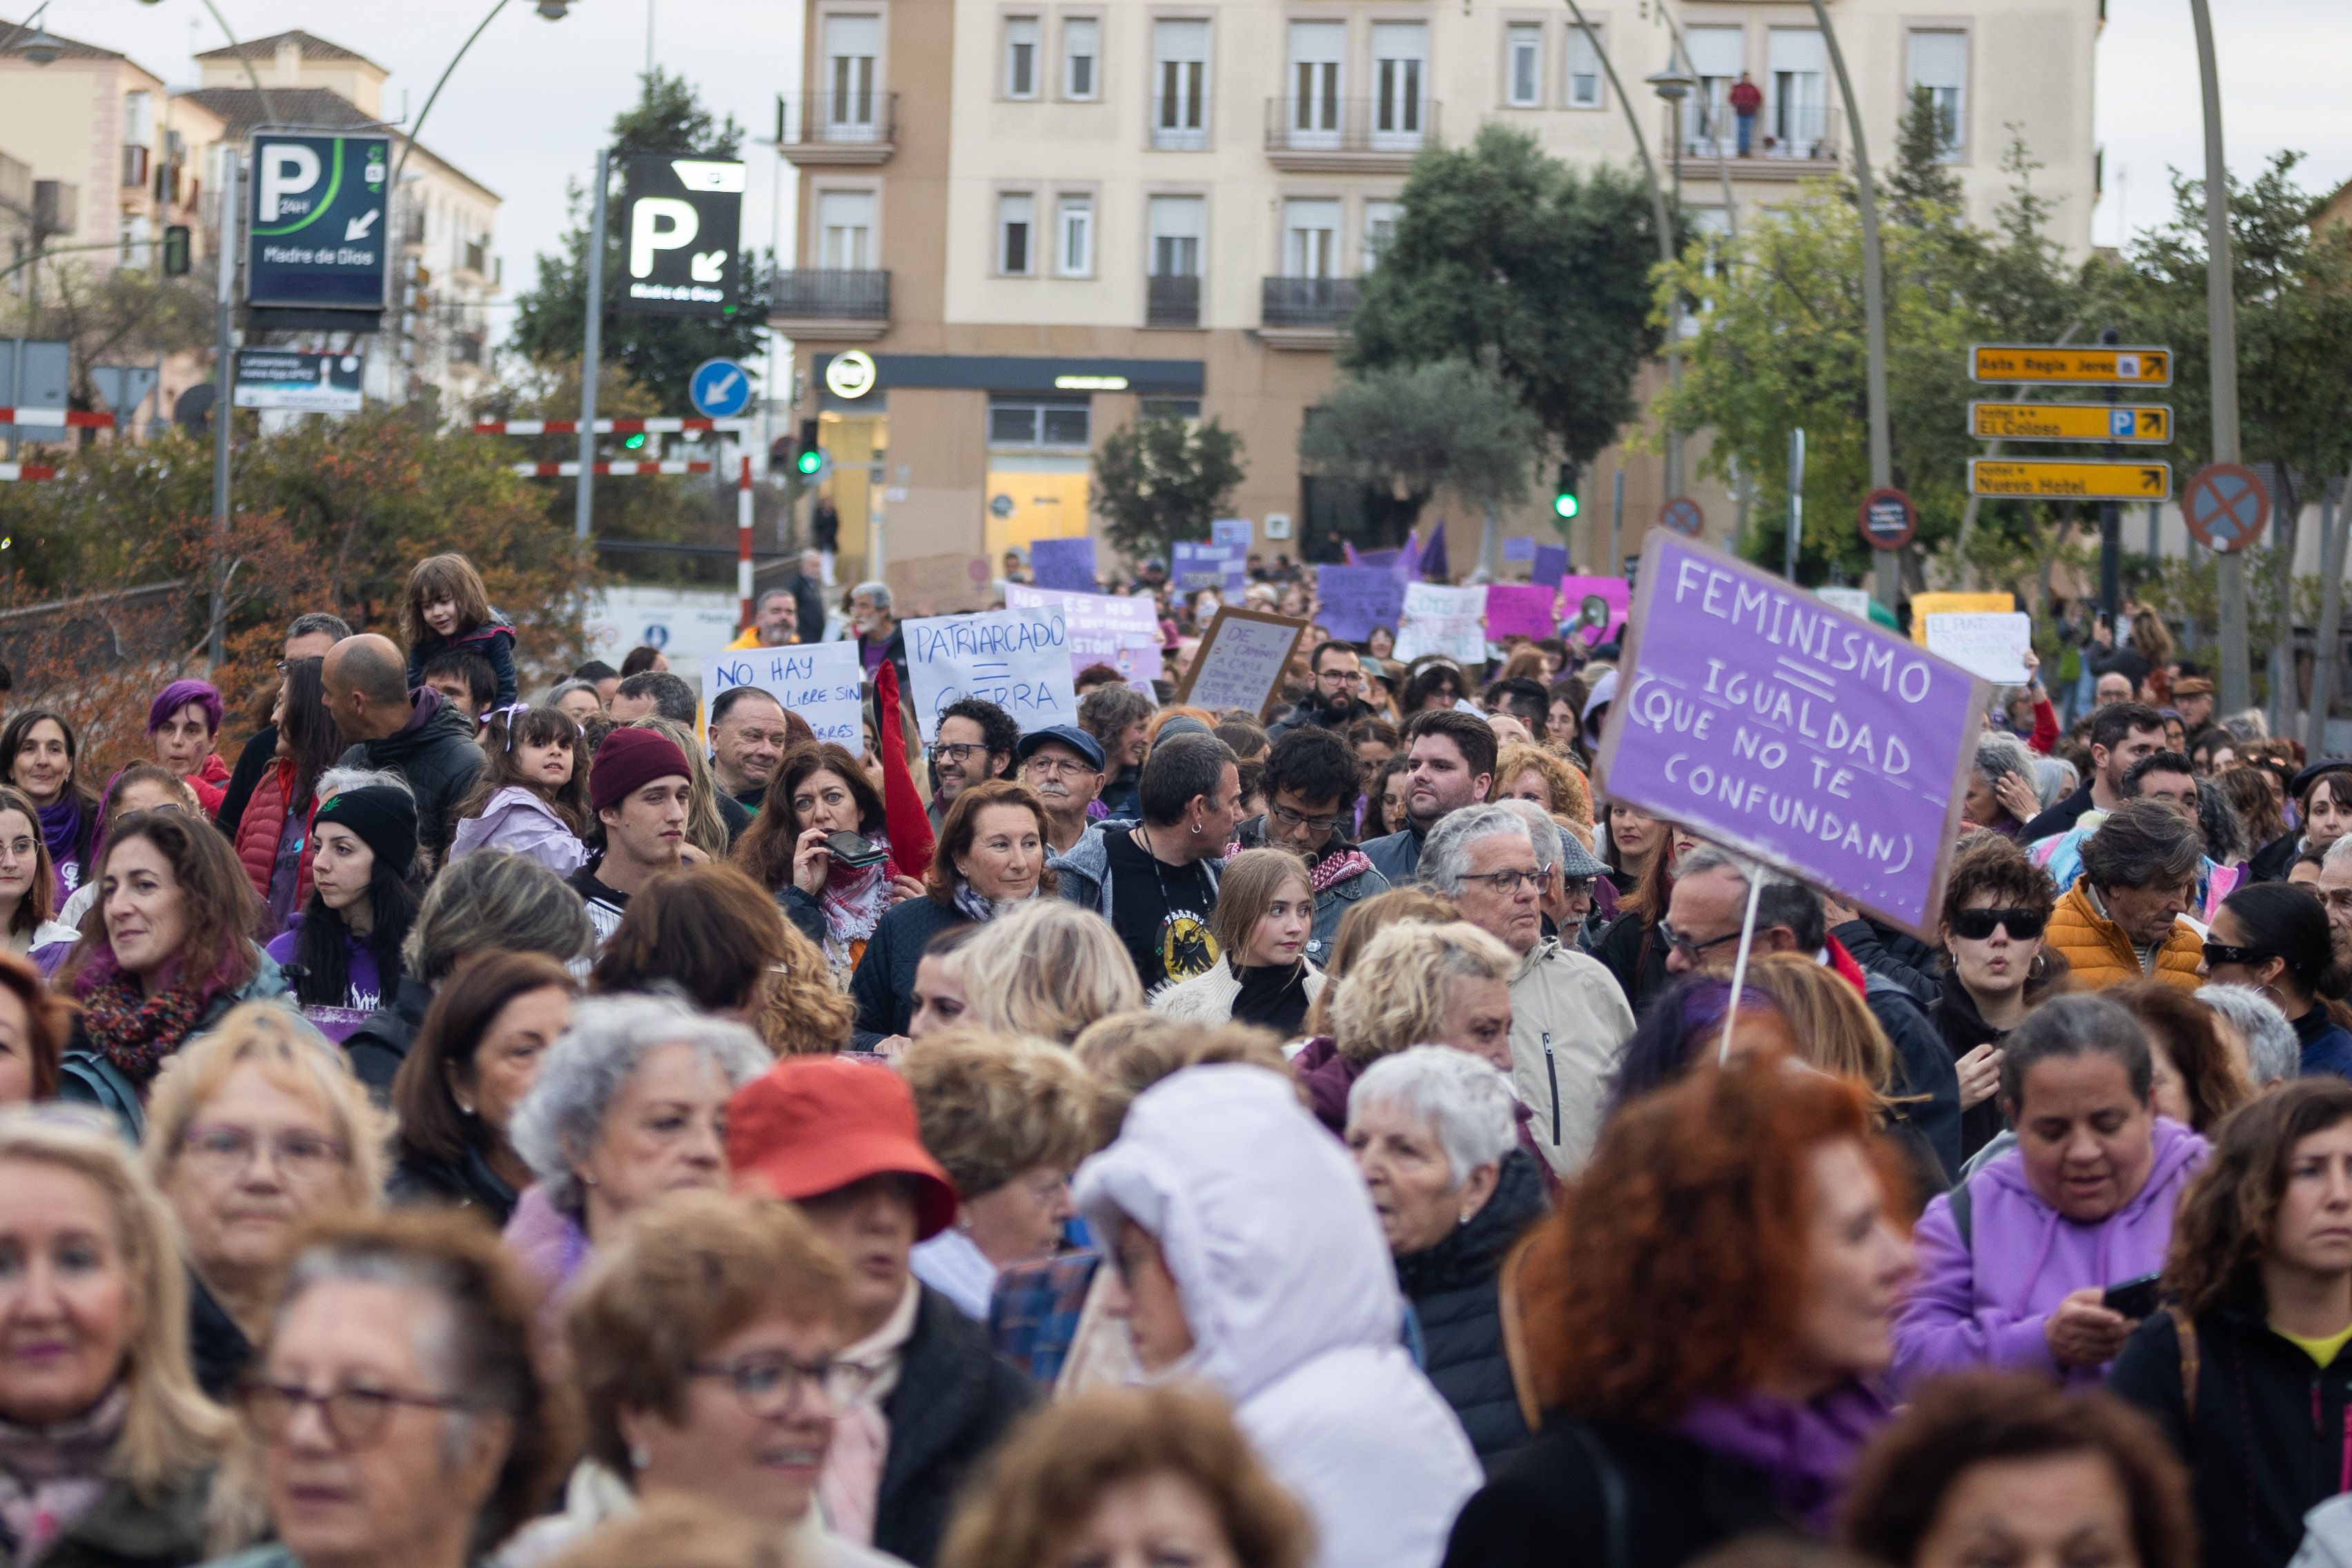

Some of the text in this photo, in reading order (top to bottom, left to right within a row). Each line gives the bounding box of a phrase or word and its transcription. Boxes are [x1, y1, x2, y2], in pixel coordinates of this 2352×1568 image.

[259, 144, 321, 222] P
[280, 197, 310, 214] 24H
[264, 246, 375, 266] Madre de Dios
[629, 197, 699, 278] P
[914, 615, 1066, 663] PATRIARCADO
[1226, 626, 1255, 643] DE
[1676, 558, 1931, 704] FEMINISMO
[716, 656, 813, 687] NO HAY
[786, 683, 861, 708] LIBRE SIN
[812, 723, 854, 741] IBRES
[1703, 658, 1910, 776] IGUALDAD
[1732, 727, 1788, 770] NO
[1810, 755, 1856, 800] TE
[1665, 752, 1914, 874] CONFUNDAN)
